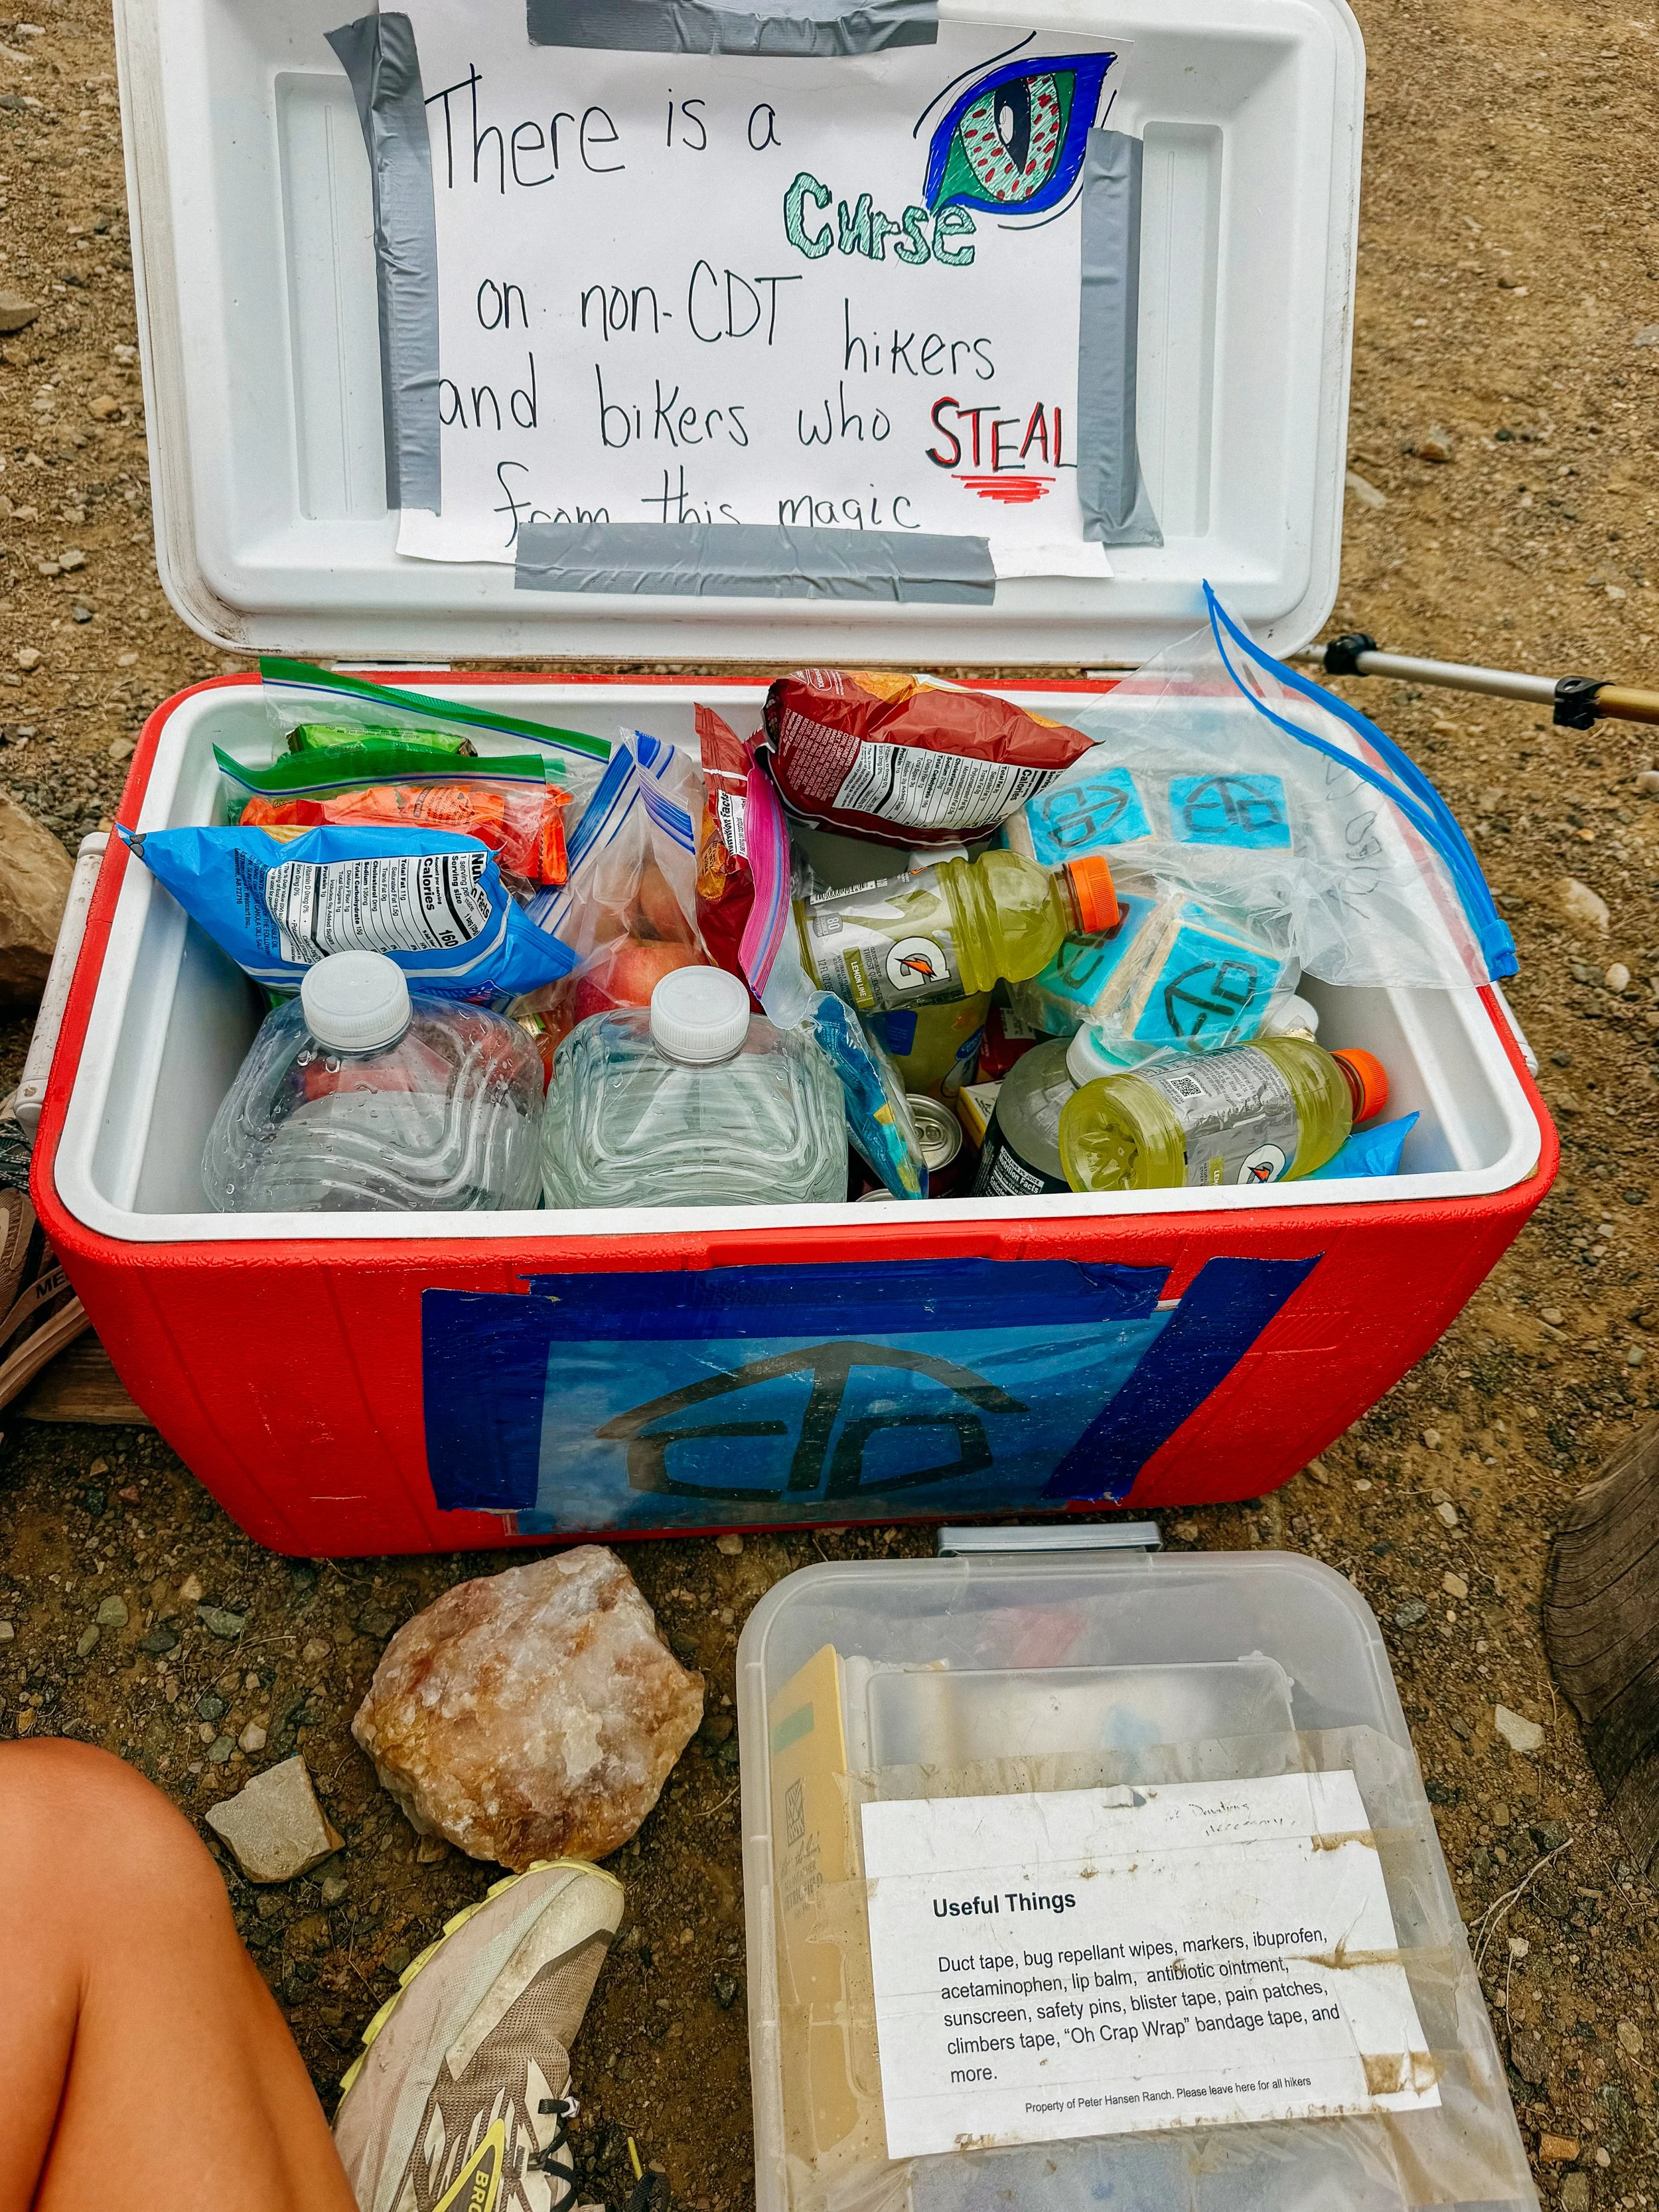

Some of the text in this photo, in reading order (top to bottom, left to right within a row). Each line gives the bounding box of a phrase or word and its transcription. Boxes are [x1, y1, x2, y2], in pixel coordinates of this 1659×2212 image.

[425, 63, 781, 194] There is a
[784, 172, 976, 266] Curse
[477, 259, 995, 380] on non-CDT hikers
[439, 352, 1077, 473] and bikers who STEAL
[494, 461, 921, 548] from this magic
[897, 748, 906, 766] Protein
[942, 757, 952, 776] Sodium
[948, 758, 961, 786] Cholesterol
[925, 770, 939, 798] Carbohydrate
[1010, 770, 1032, 801] Calories
[720, 793, 730, 818] Facts
[293, 875, 302, 887] 0mg
[293, 887, 300, 896] 0%
[422, 857, 459, 947] Calories 160
[478, 891, 490, 919] Facts
[828, 917, 839, 930] 80
[851, 961, 861, 982] LEMON
[863, 948, 883, 1001] THIRST QUENCHER
[998, 1154, 1020, 1181] Nutrition
[1019, 1177, 1039, 1194] Facts
[1026, 1173, 1039, 1185] JUICE
[933, 1892, 1076, 1917] Useful Things
[938, 1927, 1327, 1972] Duct tape, bug repellant wipes, markers, ibuprofen,
[941, 1957, 1289, 2000] acetaminophen, lip balm, antibiotic ointment,
[944, 1981, 1327, 2026] sunscreen, safety pins, blister tape, pain patches,
[948, 2036, 1015, 2055] climbers
[1019, 2033, 1060, 2051] tape,
[1100, 2025, 1138, 2043] Crap
[1195, 2013, 1263, 2032] bandage
[1267, 2010, 1307, 2028] tape,
[1312, 2003, 1340, 2021] and
[951, 2067, 997, 2083] more.
[1025, 2077, 1311, 2114] Property of Peter Hansen Ranch. Please leave here for all hikers
